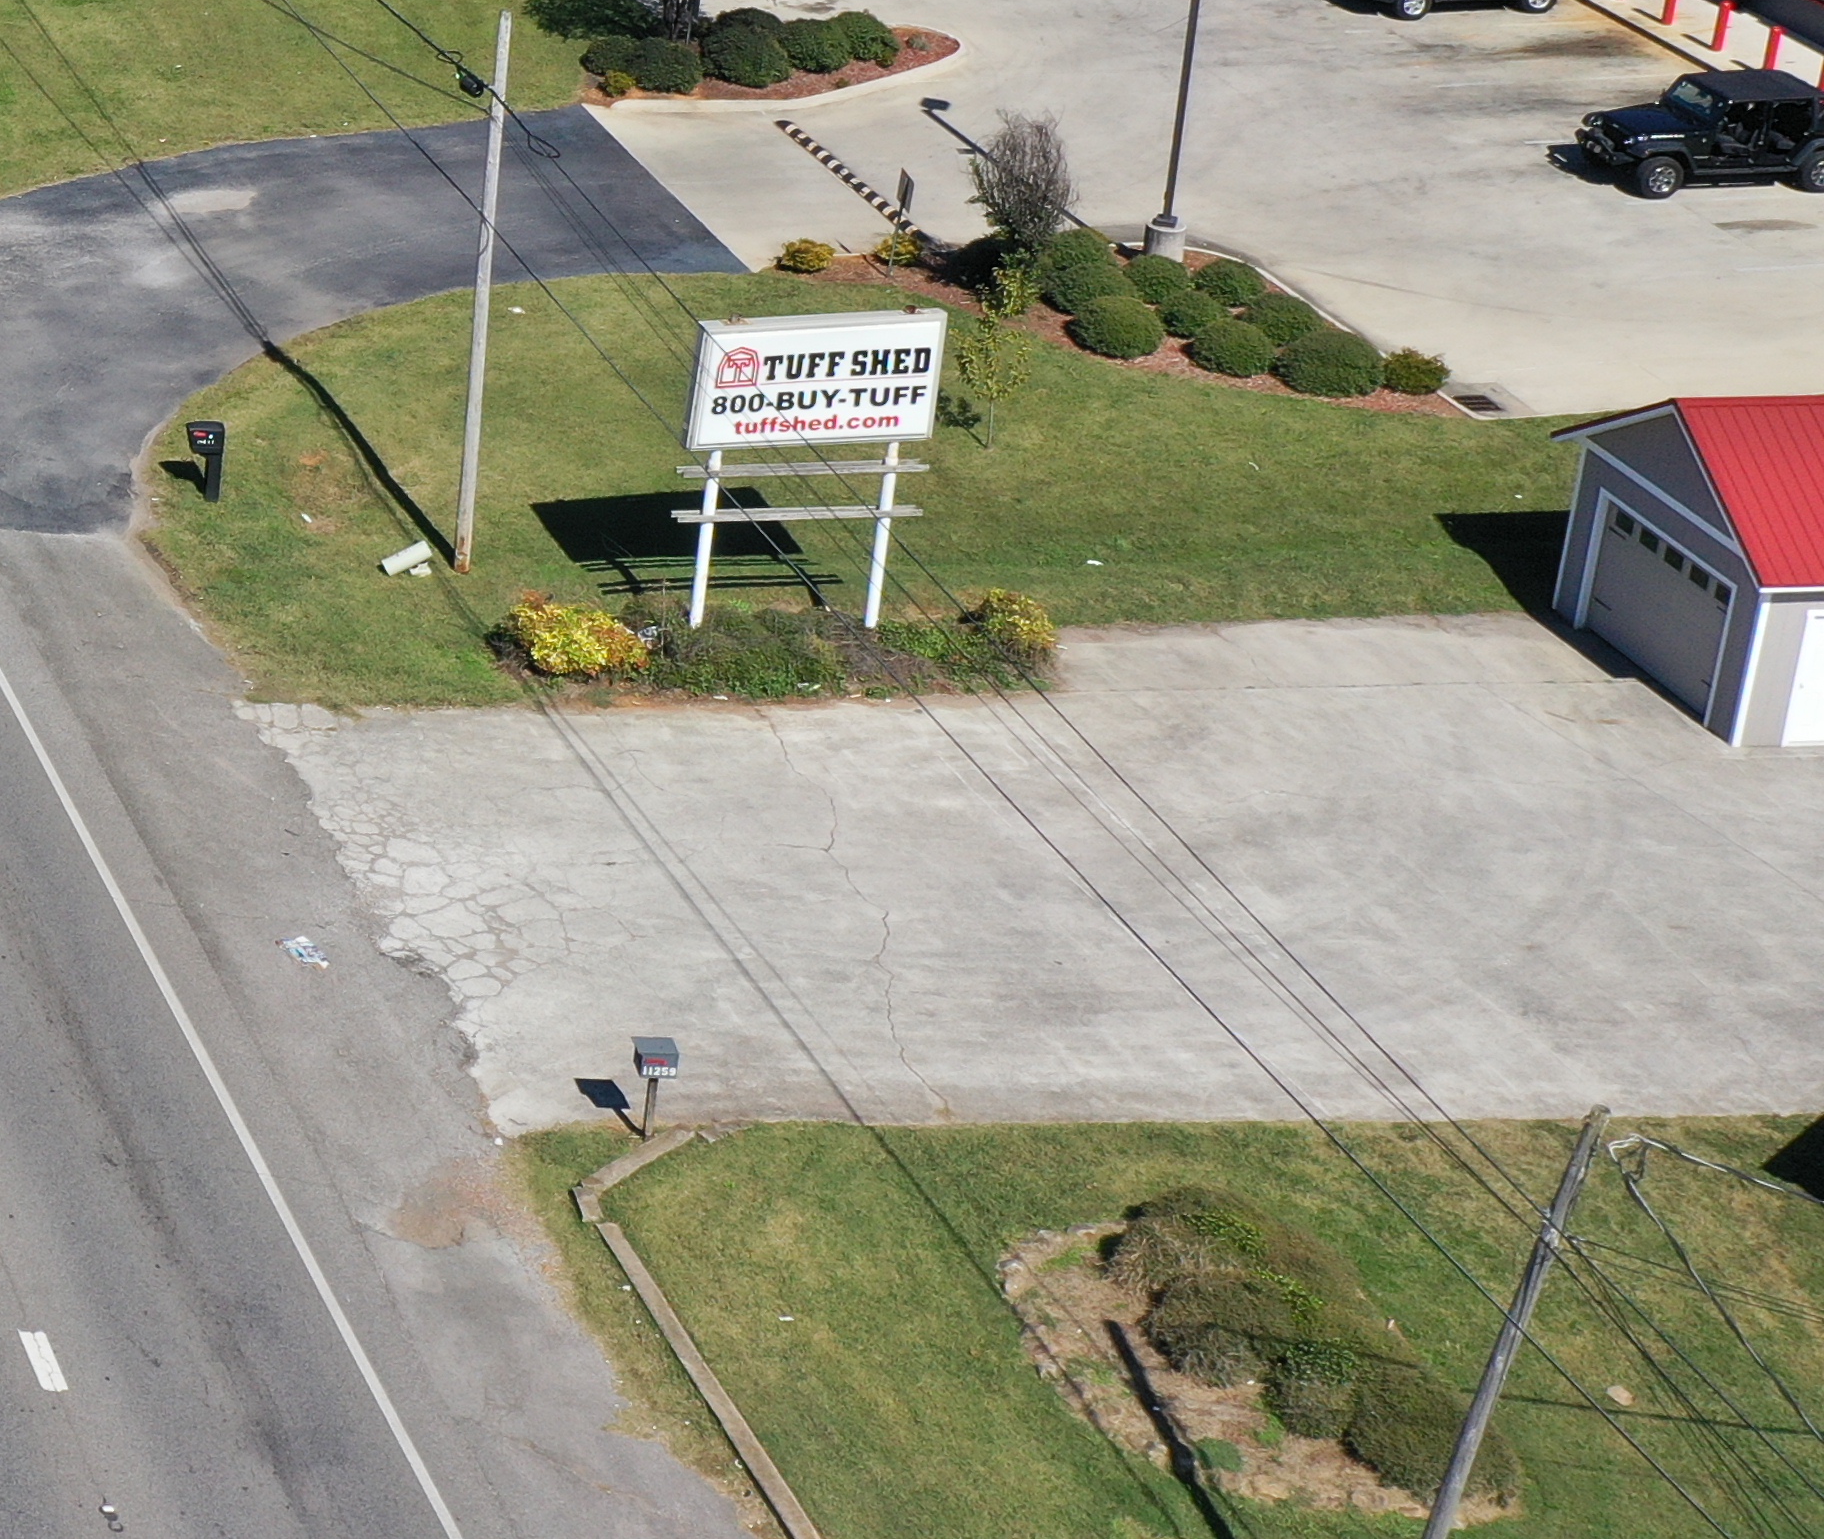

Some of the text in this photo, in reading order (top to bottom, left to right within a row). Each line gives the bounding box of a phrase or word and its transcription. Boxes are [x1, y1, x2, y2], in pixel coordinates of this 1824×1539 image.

[763, 347, 932, 381] TUFF SHED
[711, 385, 928, 415] 800-BUY-TUFF
[734, 414, 900, 435] tuffshed.com
